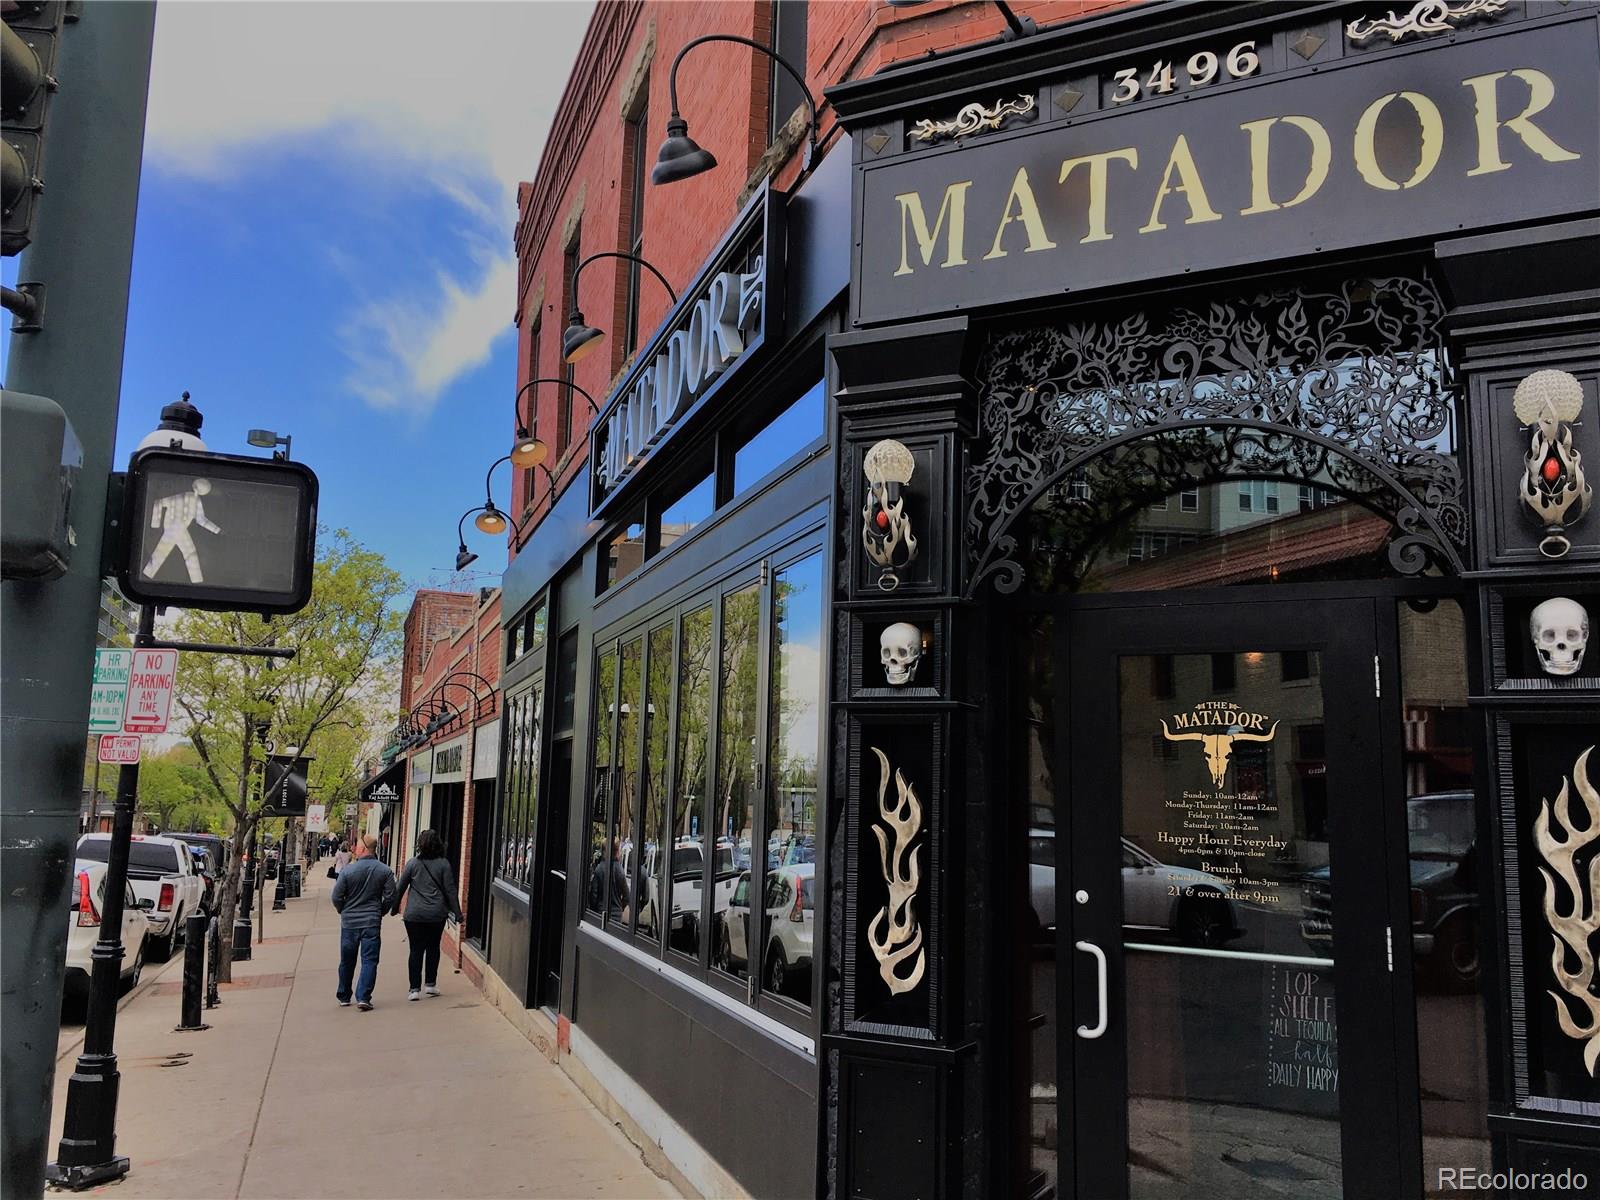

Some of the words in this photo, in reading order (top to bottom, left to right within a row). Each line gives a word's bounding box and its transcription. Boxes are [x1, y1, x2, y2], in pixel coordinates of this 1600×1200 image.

[1111, 40, 1259, 103] 3496
[893, 67, 1581, 277] MATADOR
[604, 271, 744, 489] MATADOR
[108, 653, 121, 666] HR
[145, 655, 163, 670] NO
[99, 667, 128, 681] PARKING
[132, 673, 171, 689] PARKING
[141, 690, 159, 701] ANY
[138, 702, 157, 713] TIME
[1207, 701, 1228, 710] THE
[1173, 711, 1264, 730] MATADOR
[116, 739, 136, 749] PERMIT
[102, 749, 115, 759] NOT
[118, 750, 136, 760] VALID
[1183, 791, 1212, 800] Sunday:
[1214, 792, 1258, 801] 10am-12am
[1165, 801, 1231, 811] Monday-Thursday:
[1233, 802, 1278, 811] 11am-12am
[1187, 811, 1213, 820] Friday:
[1215, 812, 1254, 821] 11am-2am
[1183, 821, 1218, 830] Saturday:
[1220, 822, 1259, 831] 10am-2am
[1158, 832, 1194, 847] Happy
[1199, 834, 1230, 846] Hour
[1233, 835, 1288, 851] Everyday
[1178, 846, 1213, 856] 4pm-6pm
[1215, 847, 1222, 855] &
[1224, 848, 1266, 857] 10pm-close
[1201, 861, 1242, 874] Brunch
[1209, 875, 1237, 885] Sunday
[1239, 877, 1279, 887] 10am-3pm
[1167, 885, 1181, 897] 21
[1185, 886, 1195, 897] &
[1198, 890, 1222, 899] over
[1224, 887, 1251, 901] after
[1253, 890, 1280, 904] 9pm
[1279, 994, 1335, 1022] SHELF
[1274, 1018, 1291, 1038] ALL
[1296, 1019, 1333, 1041] TEQUILA
[1272, 1062, 1302, 1088] DAILY
[1306, 1065, 1339, 1092] HAPPY
